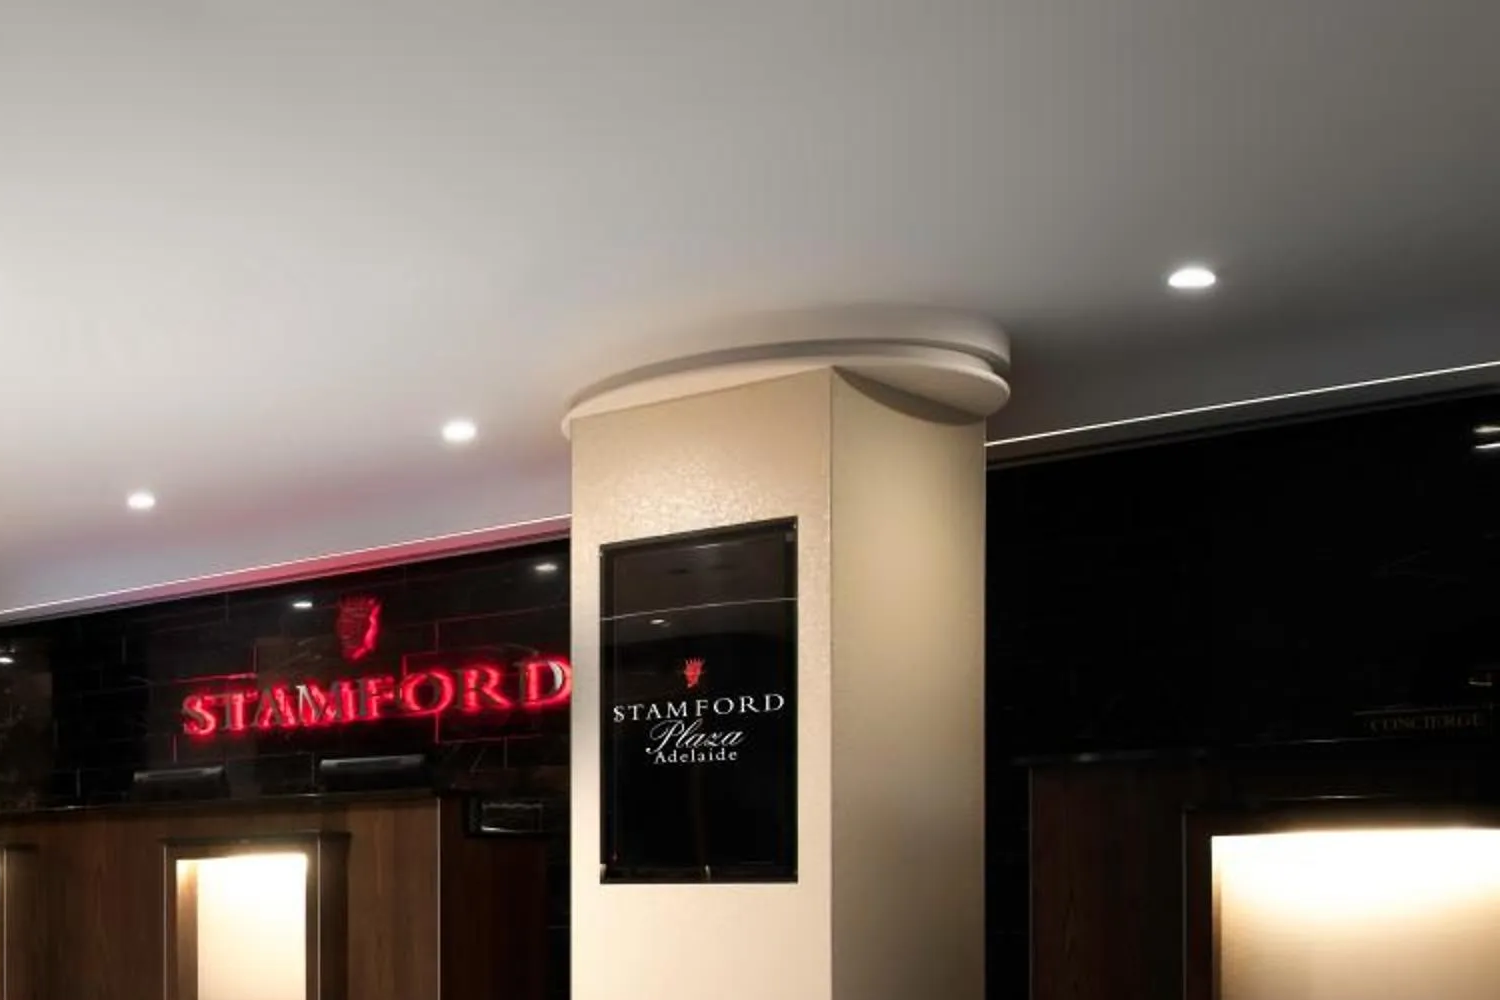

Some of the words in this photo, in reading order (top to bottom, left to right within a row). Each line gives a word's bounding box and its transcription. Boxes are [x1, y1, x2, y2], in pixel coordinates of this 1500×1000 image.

[182, 657, 571, 738] STAMFORD
[612, 693, 785, 723] STAMFORD
[645, 719, 744, 755] Plaza
[654, 748, 738, 764] Adelaide
